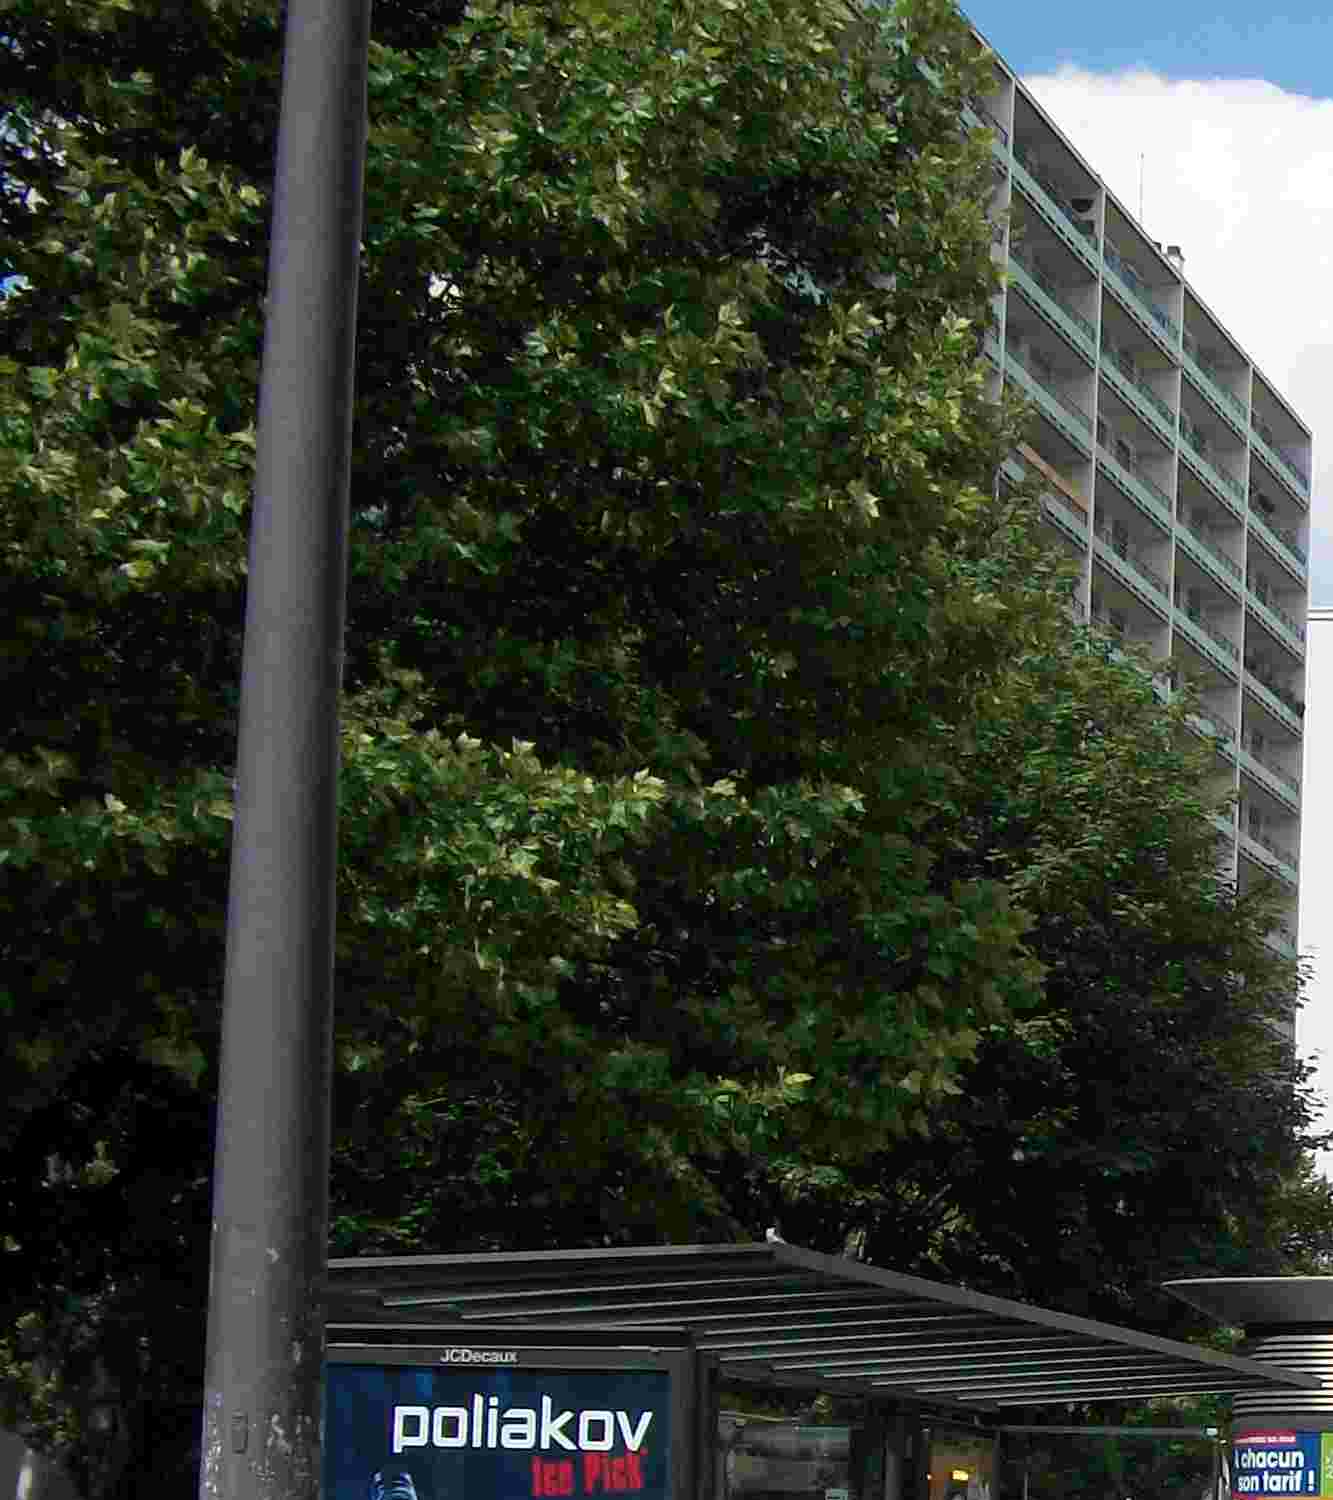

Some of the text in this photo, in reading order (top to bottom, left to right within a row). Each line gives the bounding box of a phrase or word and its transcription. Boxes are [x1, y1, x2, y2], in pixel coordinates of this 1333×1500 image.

[440, 1349, 518, 1363] JCDecaux
[392, 1393, 653, 1453] poliakov
[1241, 1448, 1305, 1469] chacun
[1262, 1469, 1302, 1492] tarif
